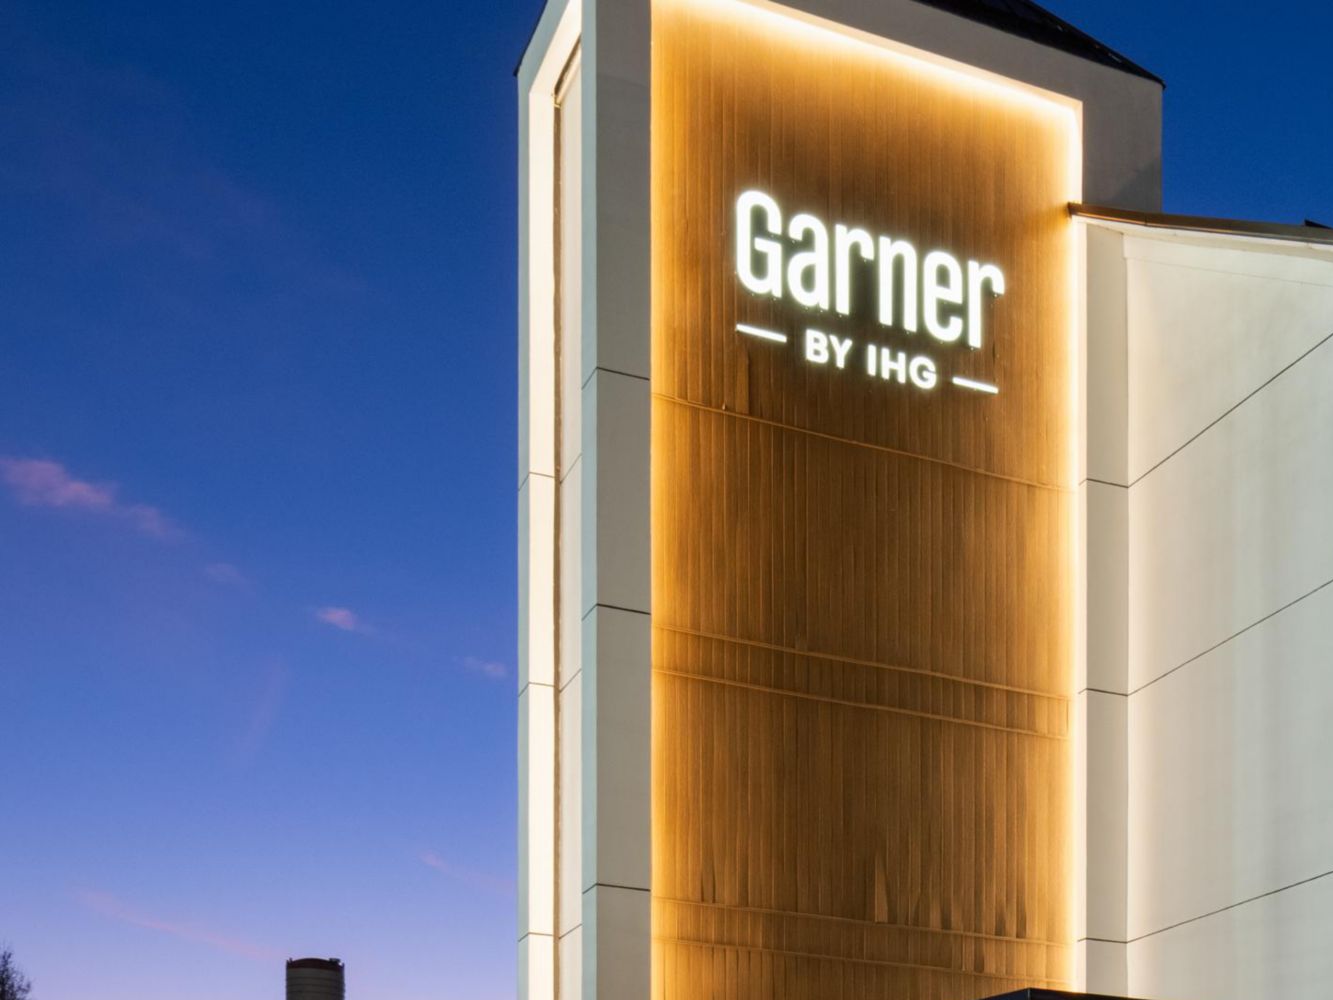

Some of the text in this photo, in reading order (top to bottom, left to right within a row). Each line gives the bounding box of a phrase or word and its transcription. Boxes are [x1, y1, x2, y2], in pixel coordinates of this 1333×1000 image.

[734, 189, 1006, 349] Garner
[804, 329, 938, 390] BY IHG
